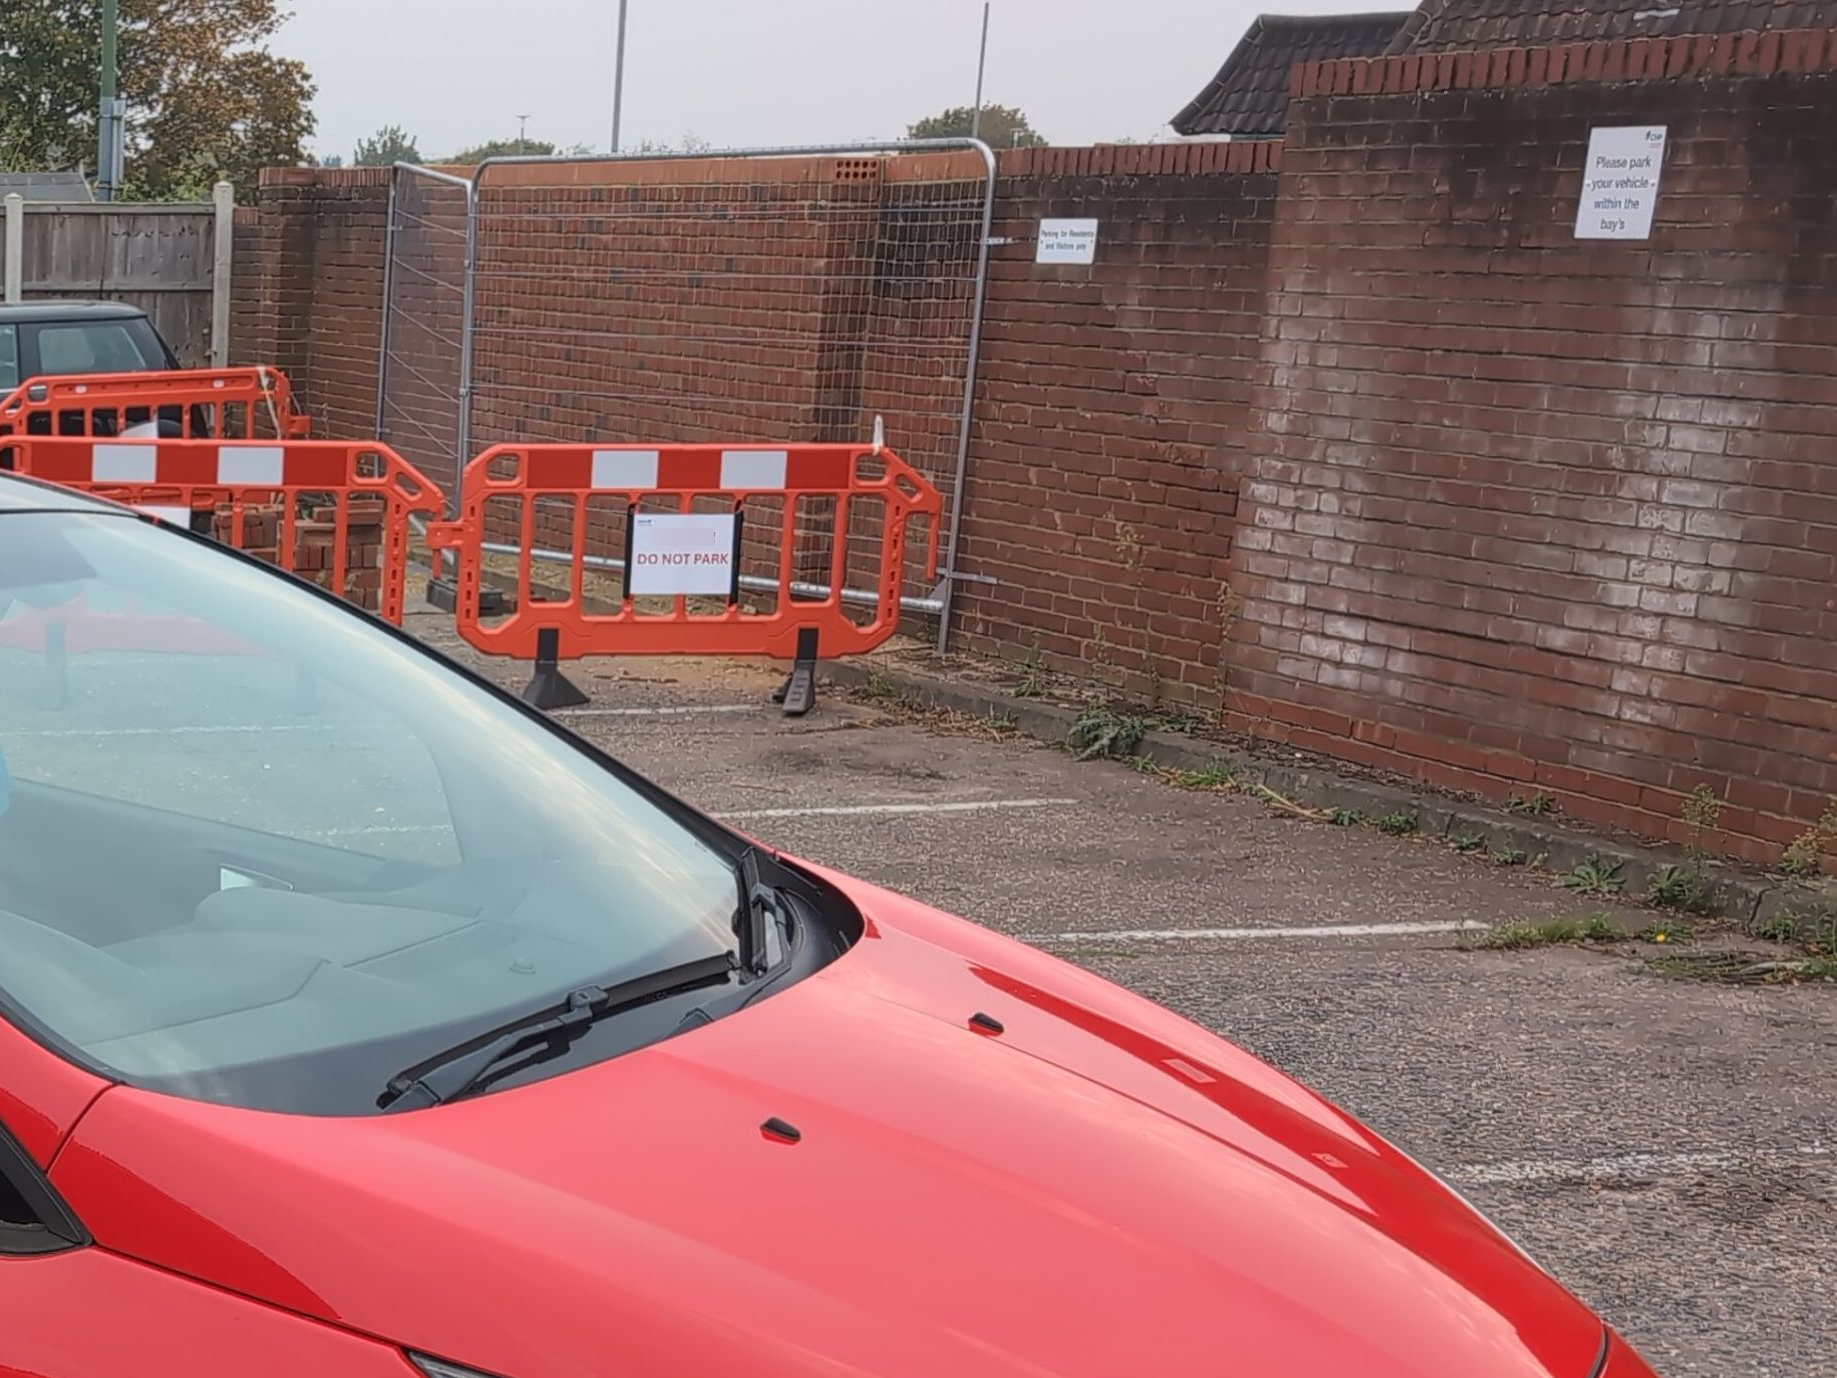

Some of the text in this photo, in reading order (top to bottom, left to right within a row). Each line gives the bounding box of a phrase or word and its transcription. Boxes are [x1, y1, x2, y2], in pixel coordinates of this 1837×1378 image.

[1596, 156, 1651, 170] Please park
[1591, 177, 1649, 191] your vehicle
[1594, 198, 1639, 209] within the
[1600, 219, 1625, 232] bay's
[637, 553, 728, 565] DO NOT PARK
